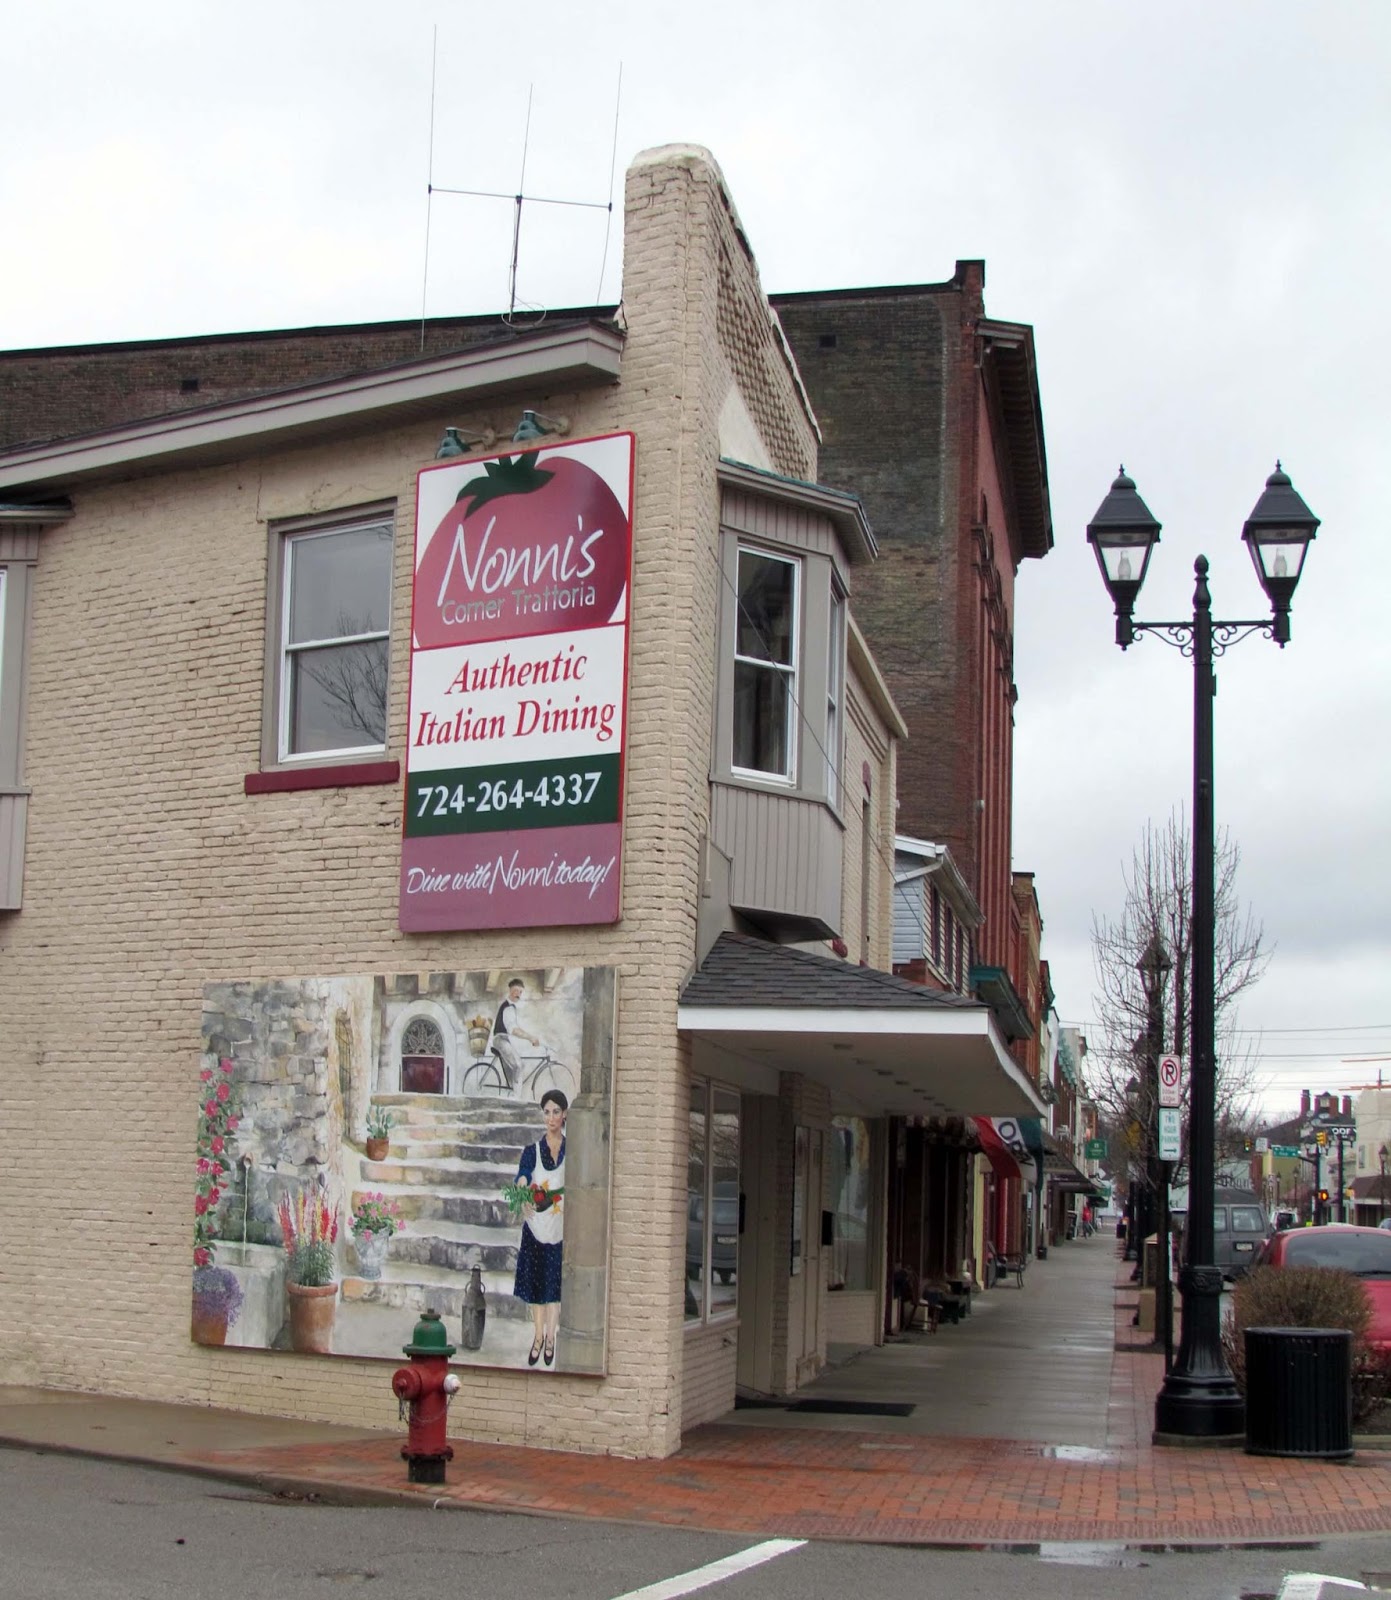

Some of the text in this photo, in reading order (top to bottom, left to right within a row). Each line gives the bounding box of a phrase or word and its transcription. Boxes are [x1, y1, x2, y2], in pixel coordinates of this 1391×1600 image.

[437, 515, 604, 607] Nonni's
[441, 580, 596, 625] Corner Trattoria
[444, 644, 588, 695] Authentic
[413, 695, 616, 747] Italian Dining
[416, 771, 602, 818] 724-264-4337
[406, 850, 616, 900] Dine with Nonni today!
